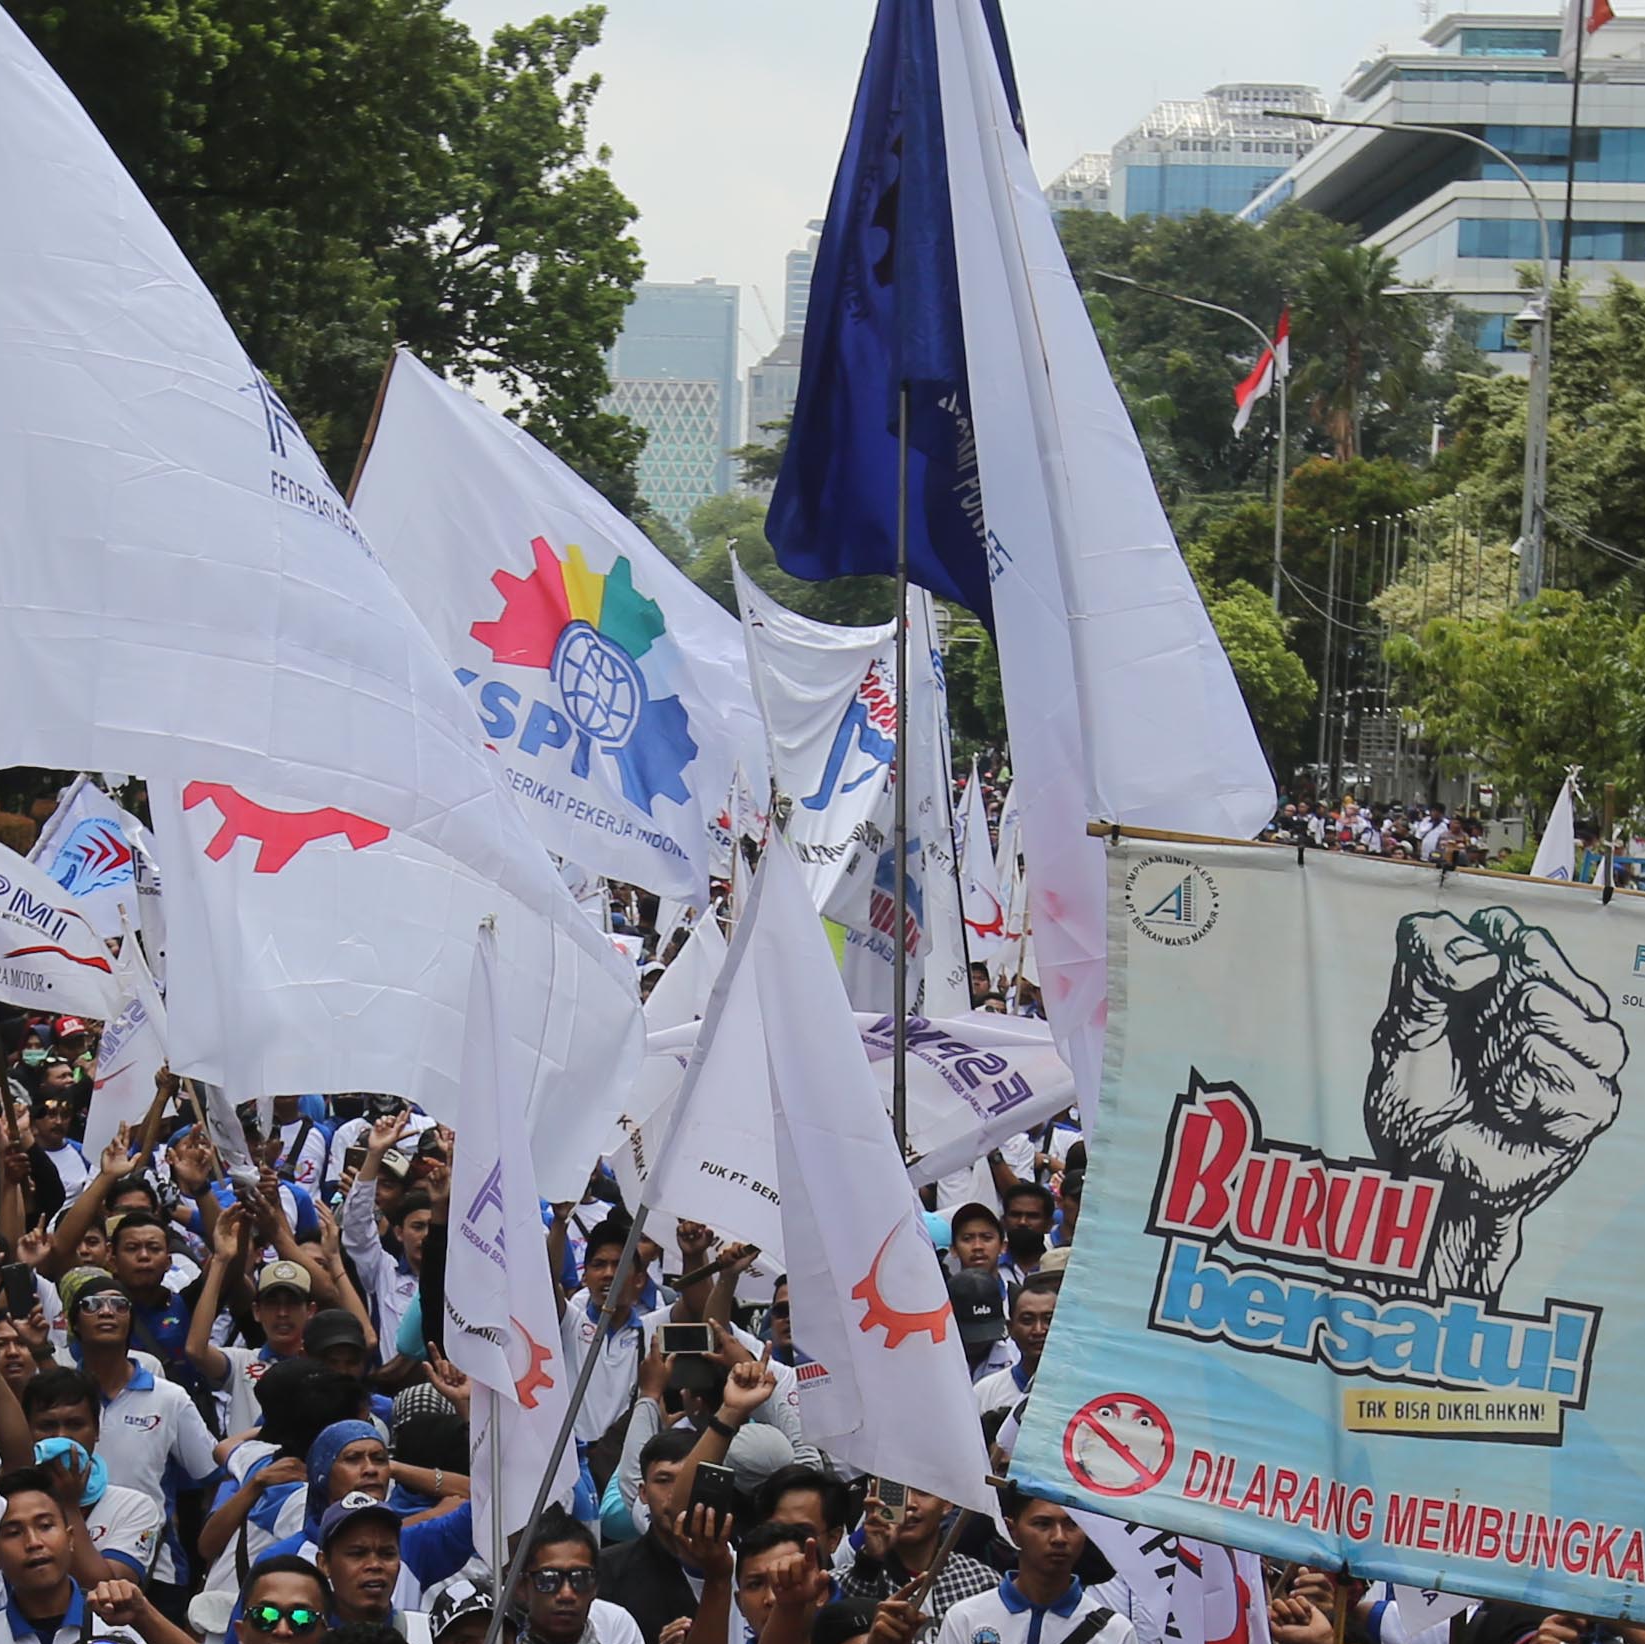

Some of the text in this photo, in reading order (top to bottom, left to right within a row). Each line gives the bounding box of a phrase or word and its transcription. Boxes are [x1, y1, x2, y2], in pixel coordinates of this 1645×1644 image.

[454, 667, 592, 780] SPI
[506, 767, 633, 837] SERIKAT PEKERJA
[1125, 855, 1220, 899] PIMPINAN UNIT KERJA
[1132, 916, 1163, 944] BERKAH
[1191, 911, 1219, 942] MAKMUR
[10, 968, 46, 993] MOTOR
[700, 1161, 730, 1179] PUK
[1159, 1088, 1447, 1280] BURUH
[1160, 1244, 1590, 1398] bersatu!
[1357, 1399, 1546, 1424] TAK BISA DIKALAHKAN!
[1184, 1448, 1374, 1541] DILARANG
